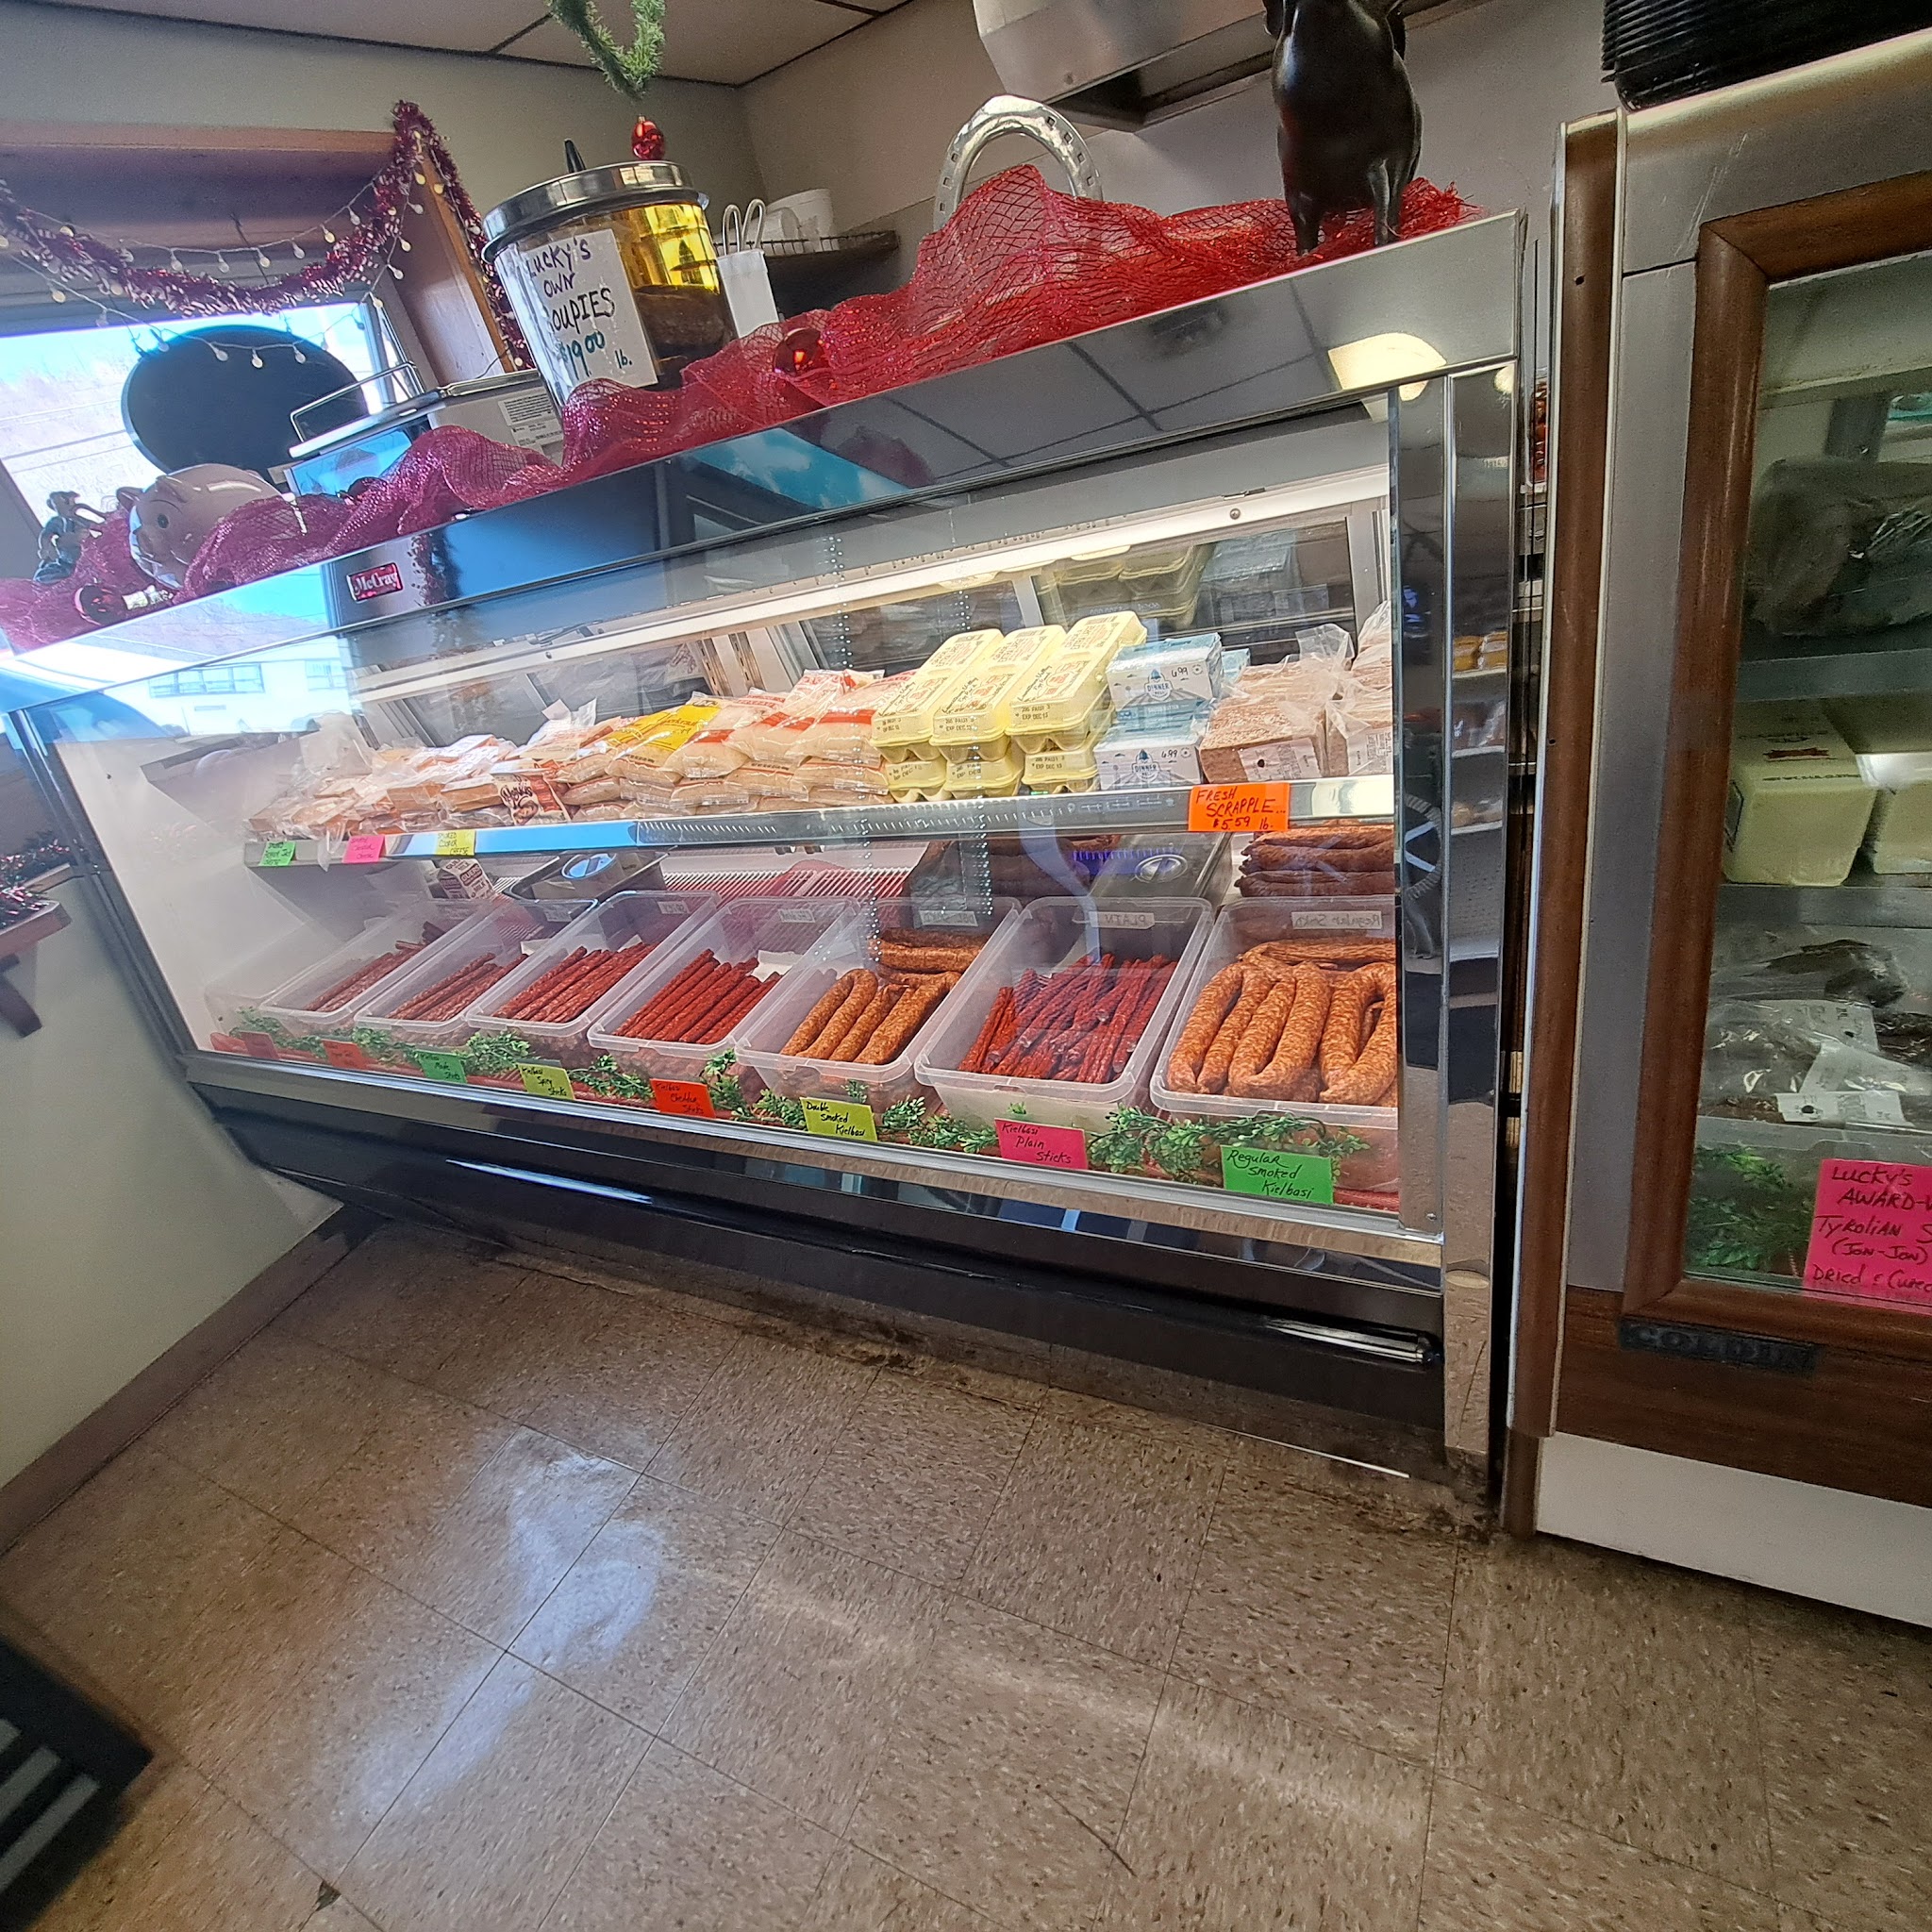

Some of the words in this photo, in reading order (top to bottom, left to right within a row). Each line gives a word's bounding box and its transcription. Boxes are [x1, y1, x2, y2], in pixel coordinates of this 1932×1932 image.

[543, 273, 575, 298] OWN
[355, 572, 397, 595] McCray
[1146, 682, 1170, 692] DINNER
[1195, 786, 1238, 804] FRESH
[1015, 1136, 1044, 1149] Plain
[1261, 1179, 1314, 1199] Kielbasi
